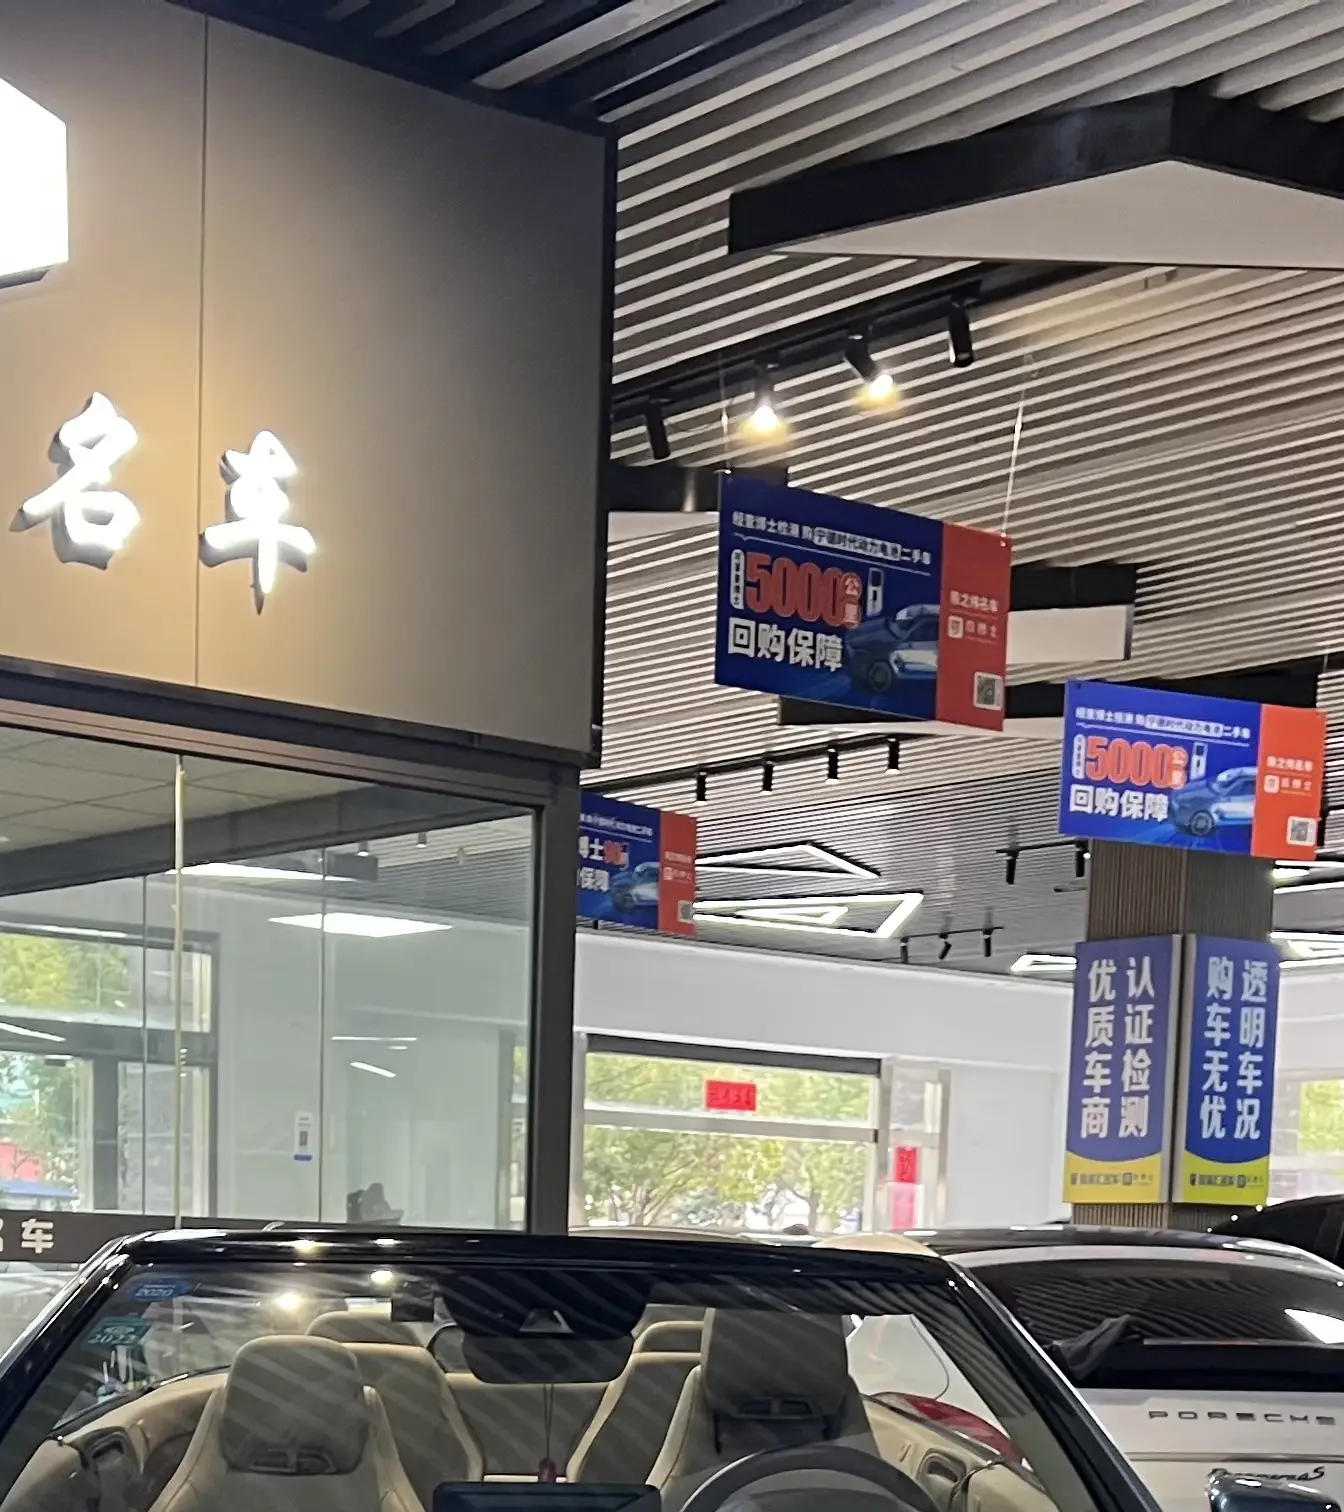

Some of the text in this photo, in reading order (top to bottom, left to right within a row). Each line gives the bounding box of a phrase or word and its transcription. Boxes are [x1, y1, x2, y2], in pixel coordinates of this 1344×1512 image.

[745, 551, 845, 627] 5000
[728, 616, 844, 672] 回购保障
[1085, 735, 1174, 788] 5000
[1069, 784, 1169, 822] 回购保障
[1080, 958, 1117, 1138] 优质车商
[1118, 956, 1155, 1138] 认证检测
[1200, 956, 1234, 1139] 购车无忧
[1234, 960, 1268, 1139] 透明车况
[1149, 1410, 1336, 1426] PORSCHE
